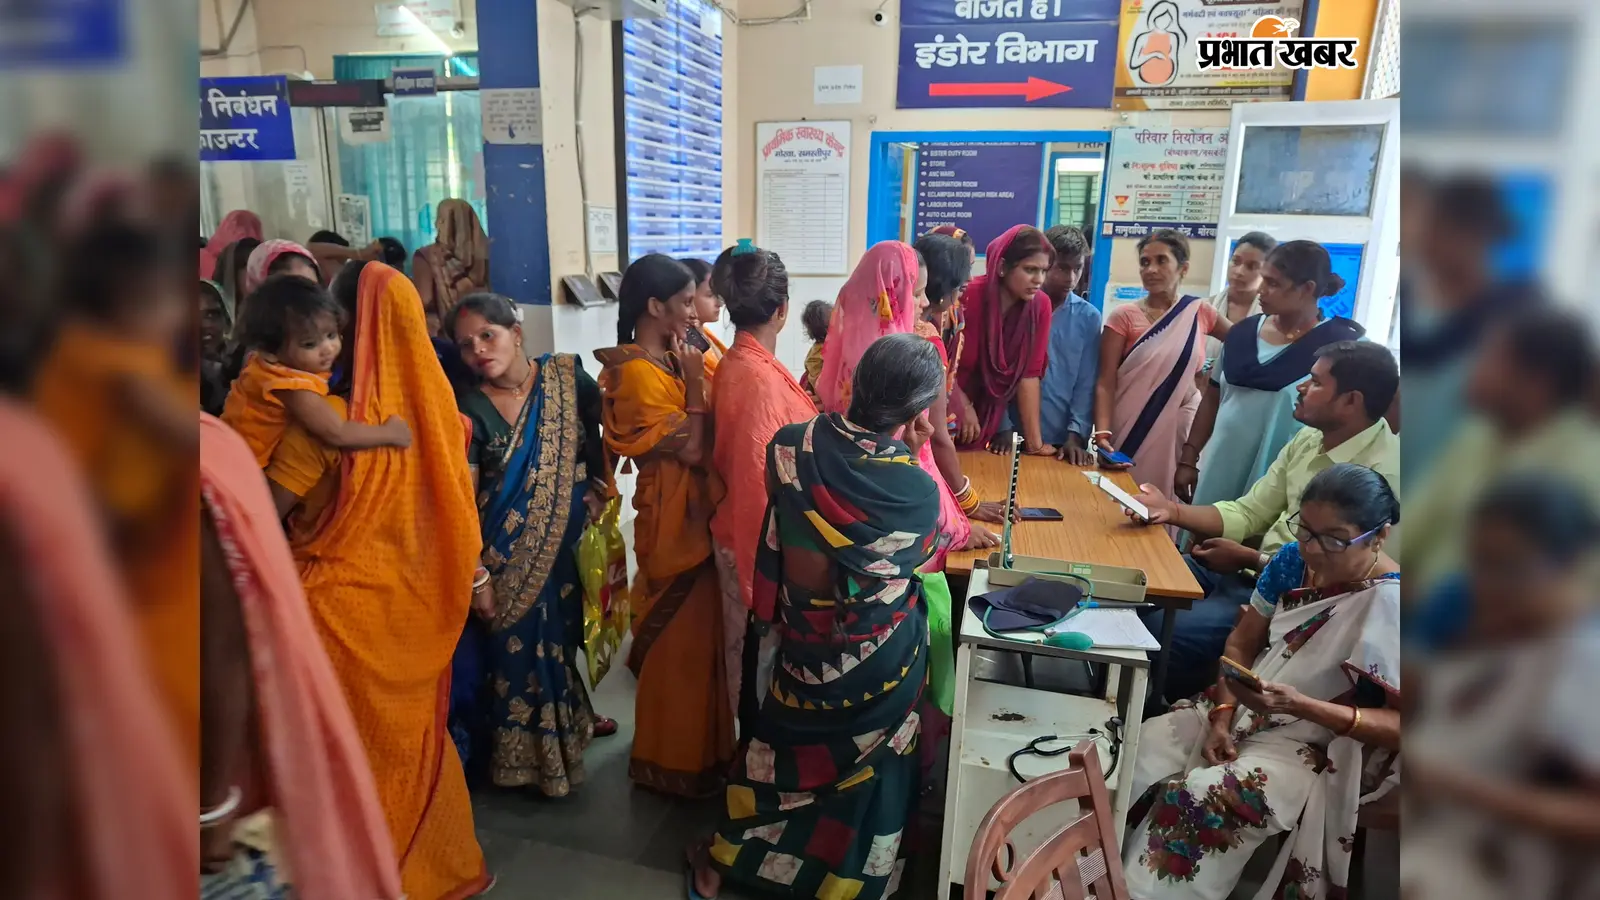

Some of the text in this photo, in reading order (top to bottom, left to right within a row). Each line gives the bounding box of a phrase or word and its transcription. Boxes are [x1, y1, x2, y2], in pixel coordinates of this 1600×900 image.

[914, 31, 1099, 69] इंडोर विभाग
[207, 88, 278, 118] निबंधन
[1135, 129, 1169, 144] परिवार
[1172, 129, 1214, 145] नियोजन
[798, 147, 832, 161] समस्तीपुर
[928, 170, 939, 178] ANC
[928, 180, 962, 188] OBSERVATION
[971, 191, 986, 199] (HIGH
[998, 191, 1015, 199] AREA)
[1115, 223, 1149, 237] सामुदायिक
